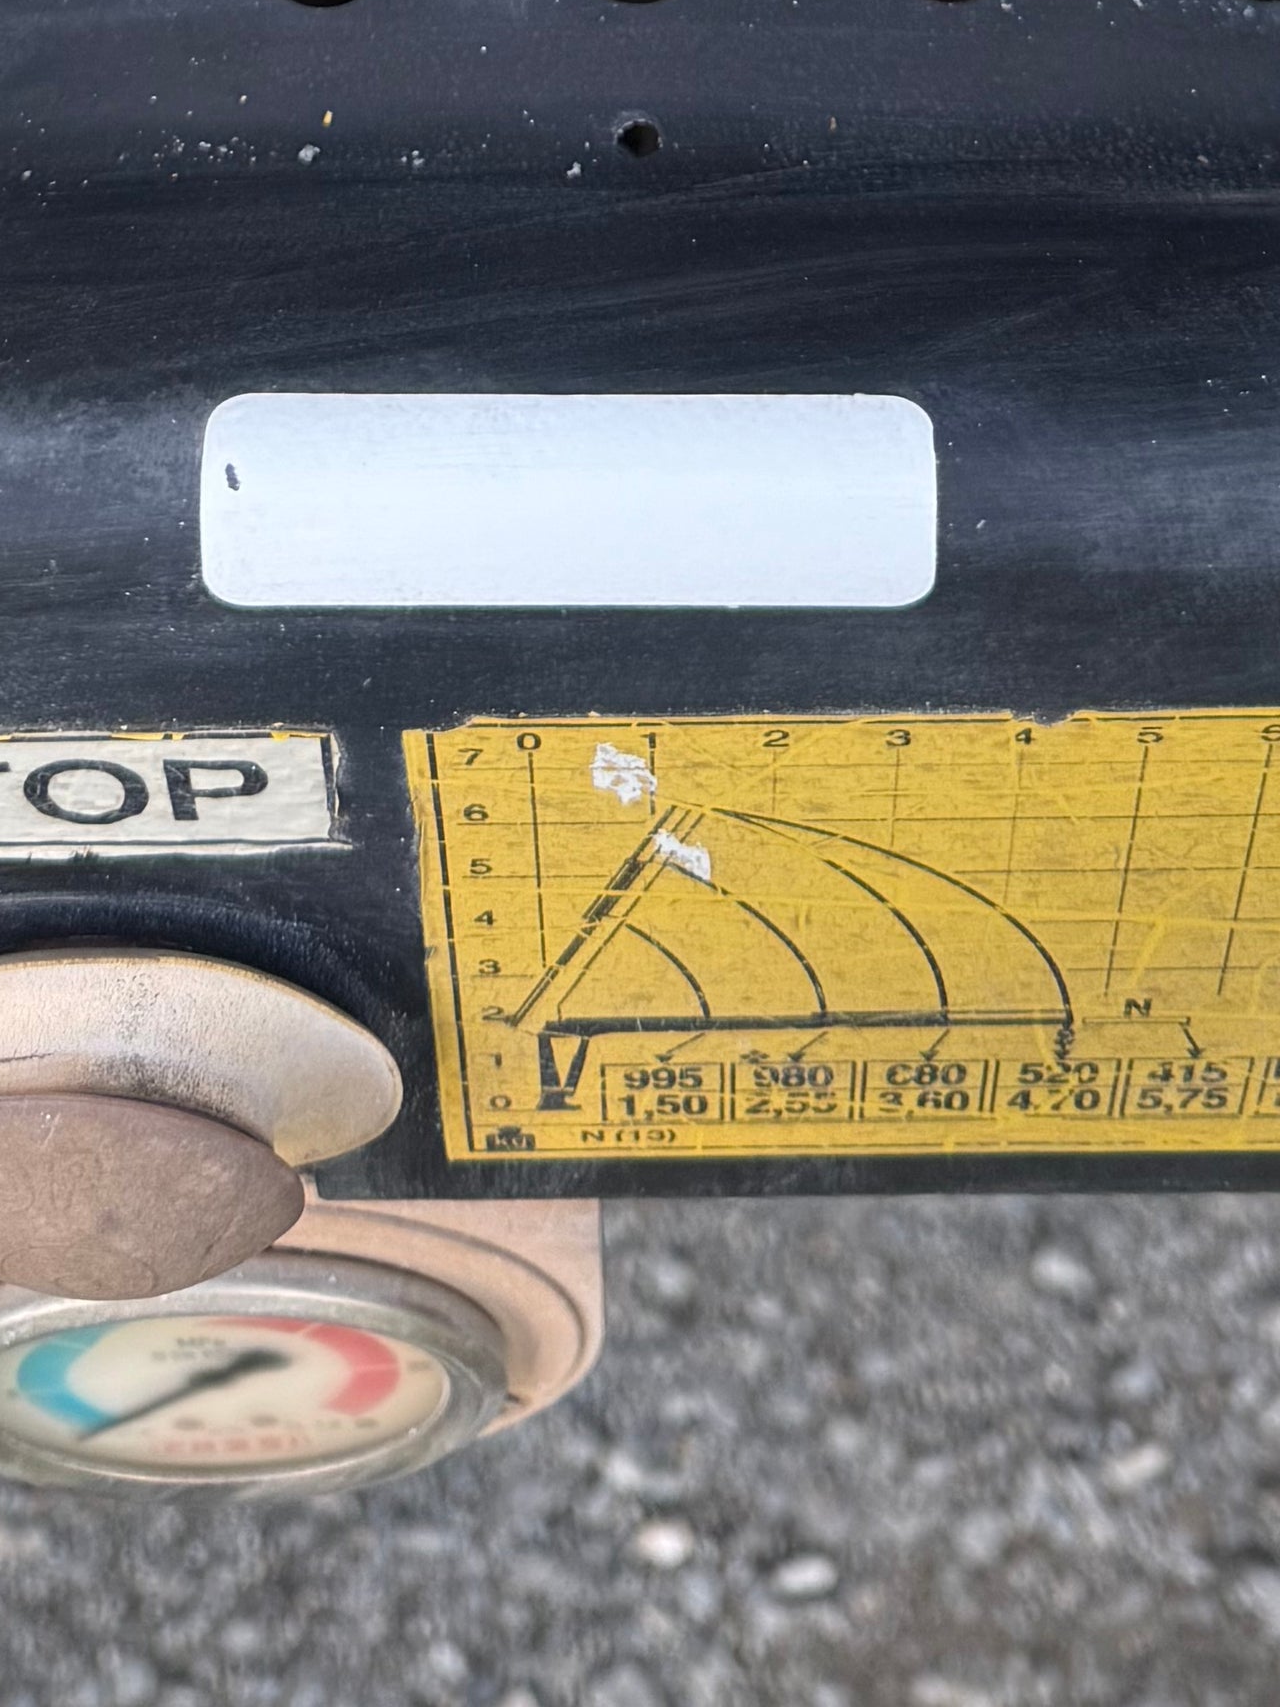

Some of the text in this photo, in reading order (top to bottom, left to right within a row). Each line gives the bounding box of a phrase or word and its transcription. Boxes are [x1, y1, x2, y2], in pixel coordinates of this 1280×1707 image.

[516, 731, 542, 751] 0
[763, 729, 791, 748] 2
[885, 728, 913, 748] 3
[1014, 727, 1036, 746] 4
[1136, 726, 1164, 744] 5
[458, 747, 484, 766] 7
[463, 803, 490, 822] 6
[469, 857, 493, 876] 5
[473, 909, 497, 926] 4
[478, 958, 502, 975] 3
[481, 1005, 505, 1022] 2
[624, 1065, 703, 1090] 995
[753, 1065, 834, 1088] 980
[489, 1094, 513, 1110] 0
[617, 1093, 708, 1120] 1,50
[1137, 1087, 1227, 1115] 5,75
